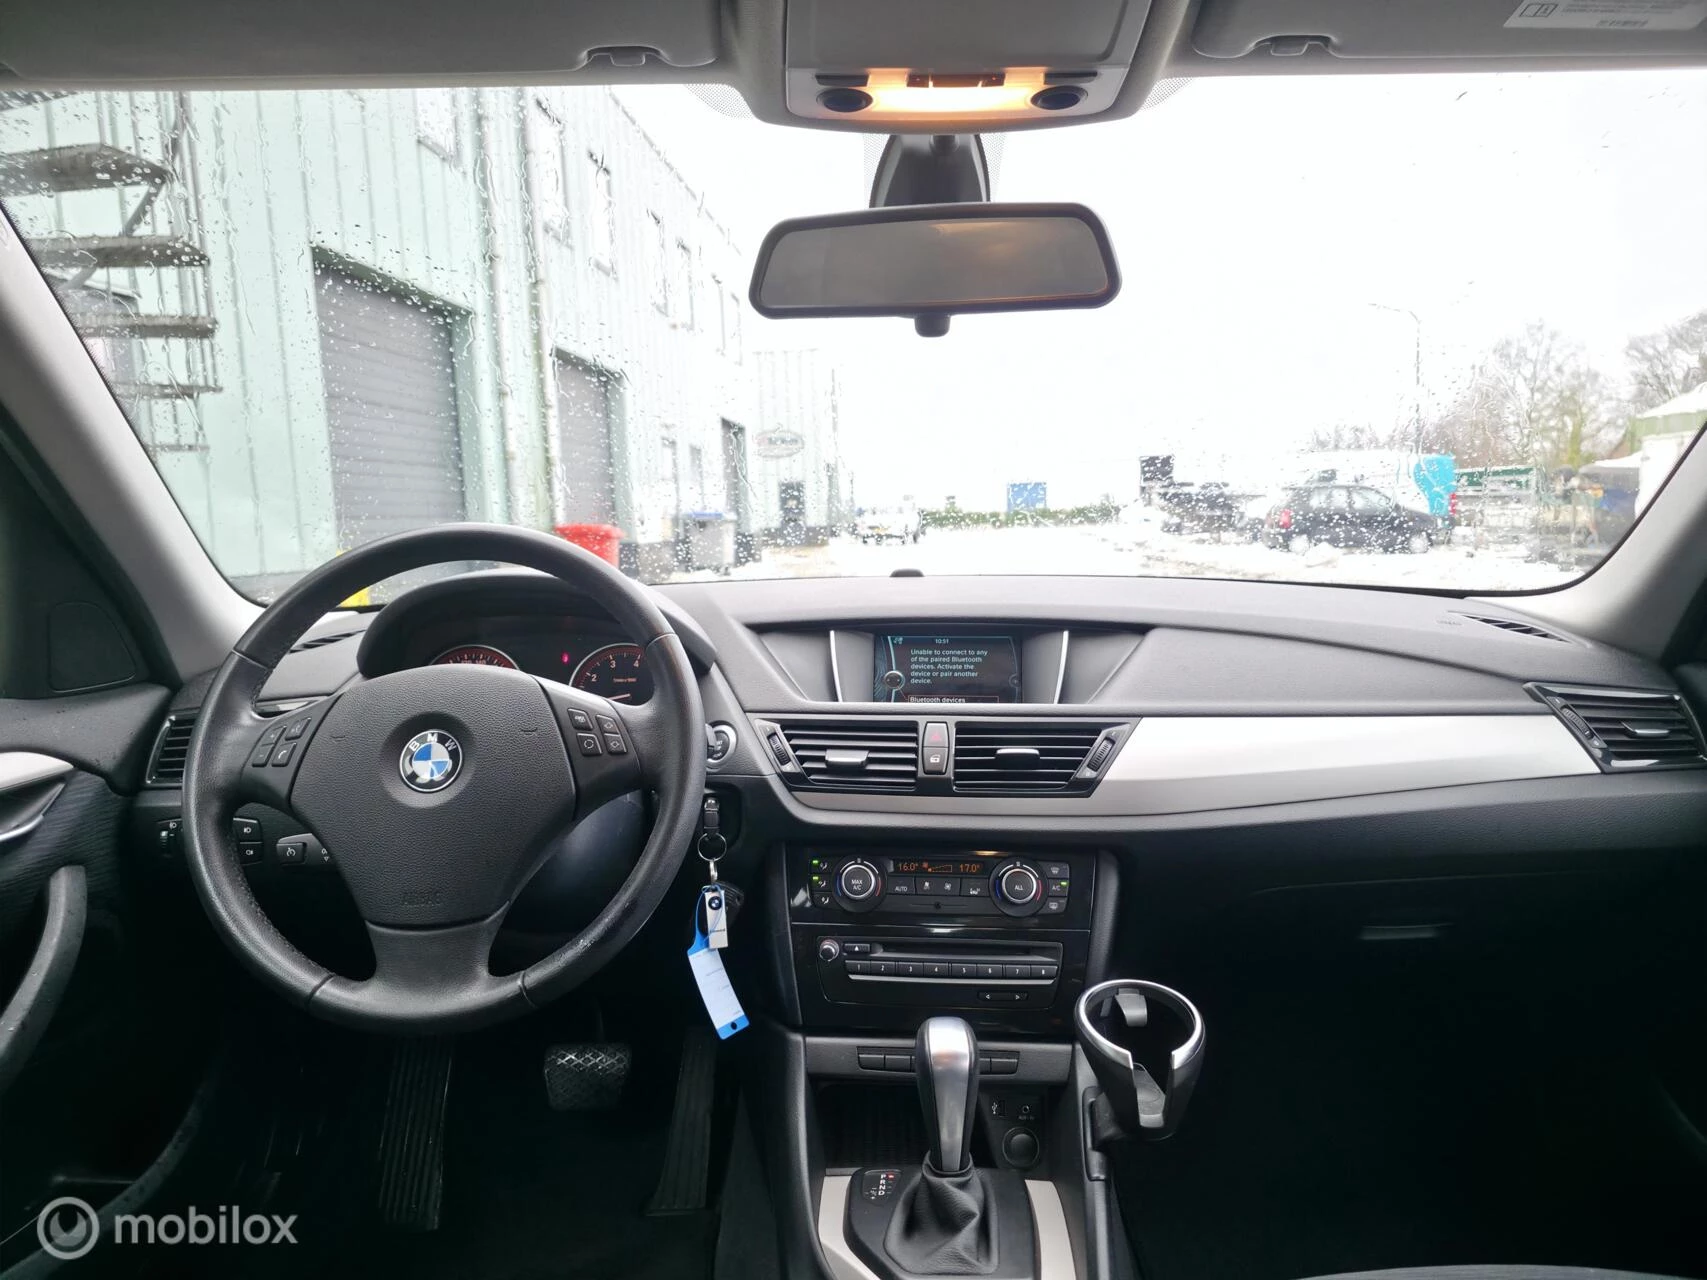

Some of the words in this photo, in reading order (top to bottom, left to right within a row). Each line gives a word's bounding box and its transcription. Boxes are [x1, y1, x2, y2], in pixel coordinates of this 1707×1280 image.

[609, 660, 616, 668] 3
[633, 660, 640, 668] 4
[930, 656, 950, 664] paired
[591, 674, 597, 682] 2
[409, 732, 457, 752] BMW
